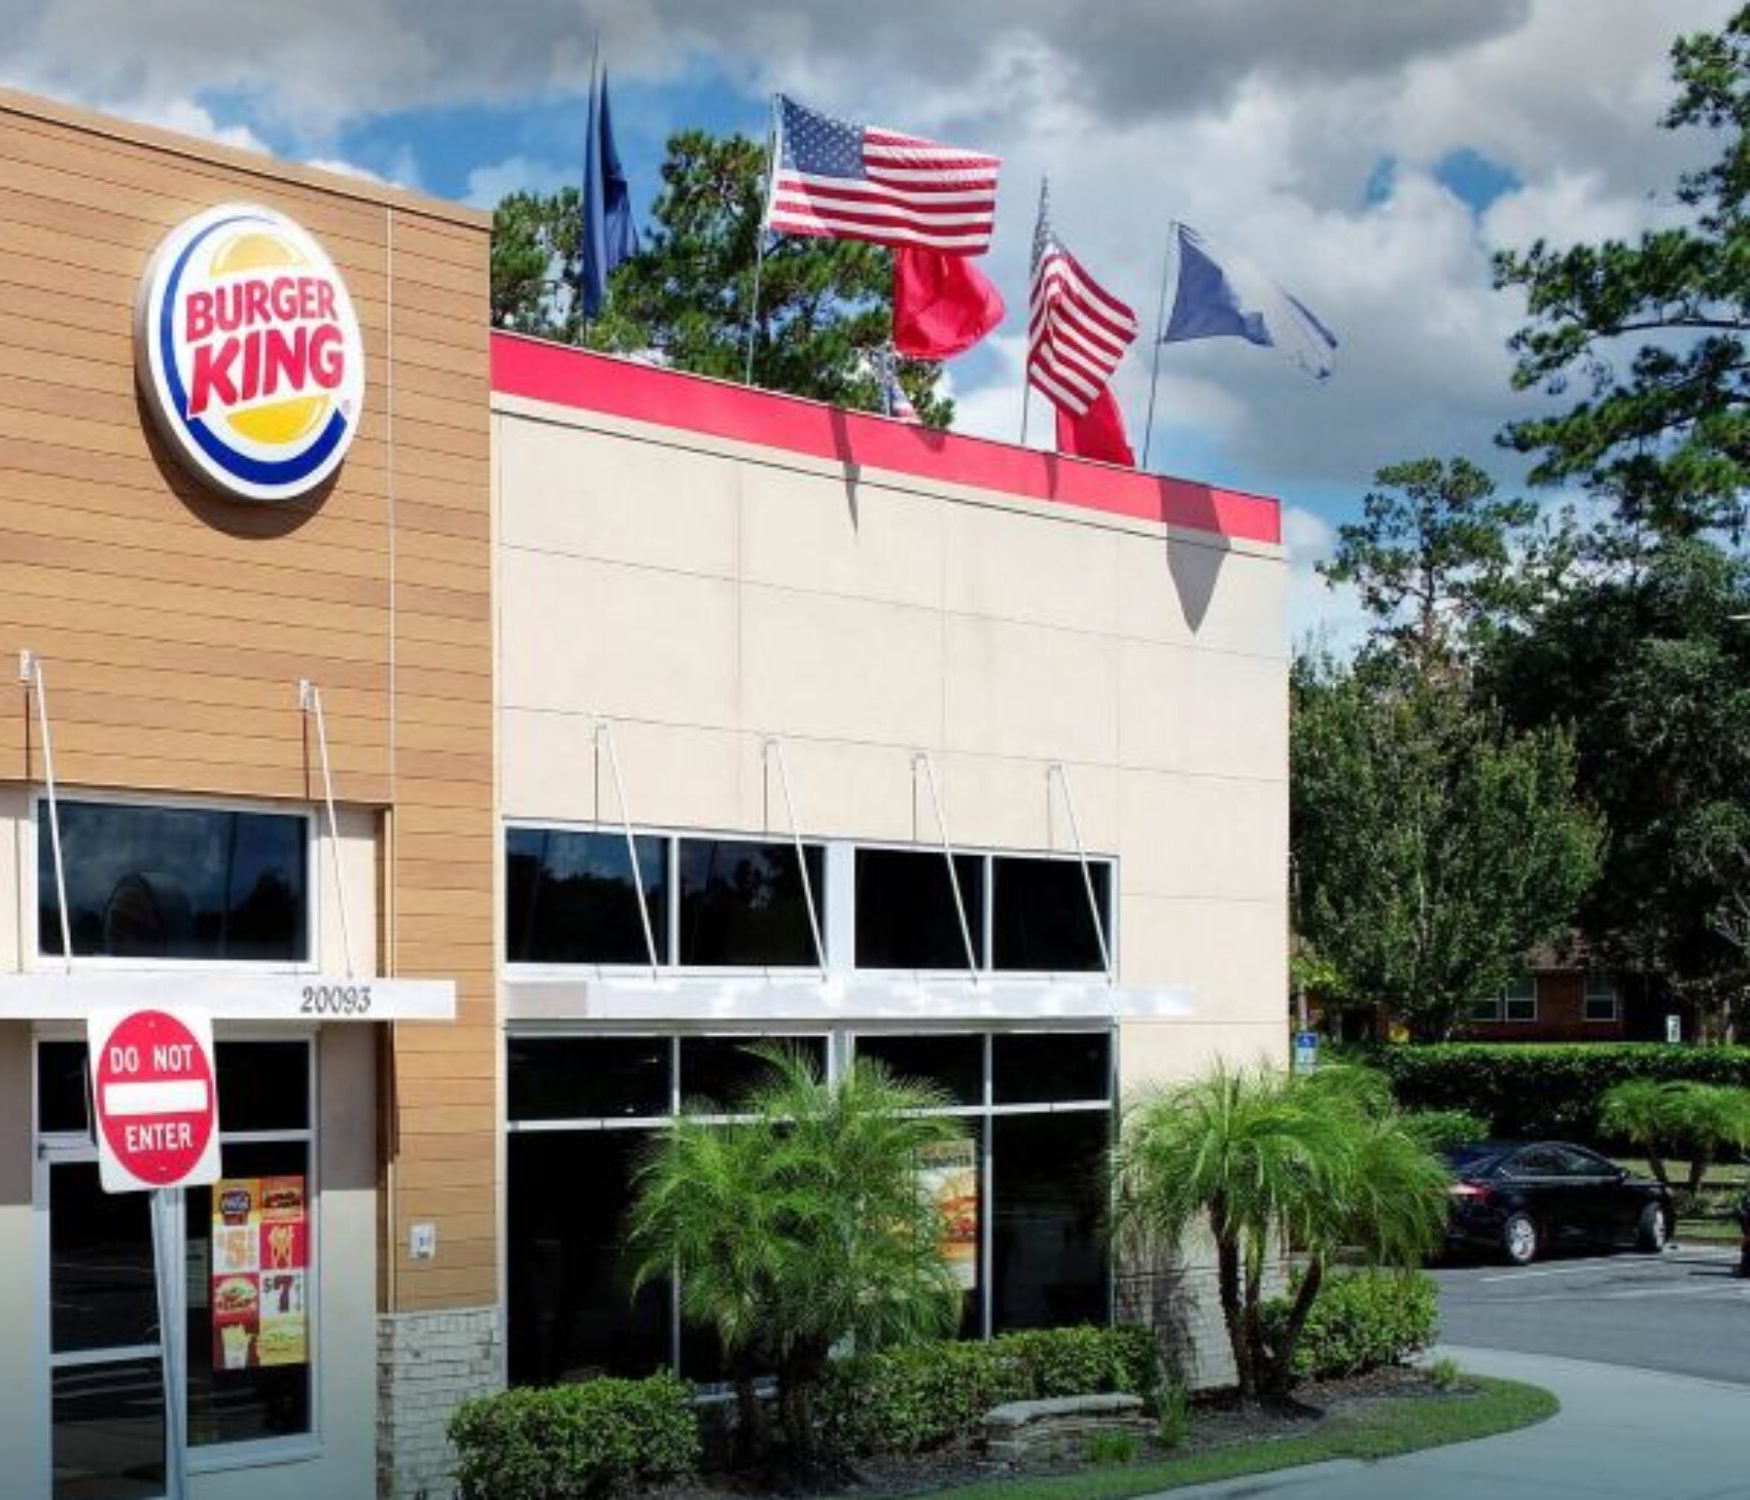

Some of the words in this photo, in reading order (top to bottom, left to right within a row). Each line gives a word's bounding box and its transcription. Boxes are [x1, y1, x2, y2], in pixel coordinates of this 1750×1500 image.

[186, 276, 338, 342] BURGER
[189, 323, 344, 415] KING
[300, 986, 372, 1014] 20093
[110, 1047, 140, 1074] DO
[153, 1044, 194, 1072] NOT
[124, 1121, 194, 1152] ENTER
